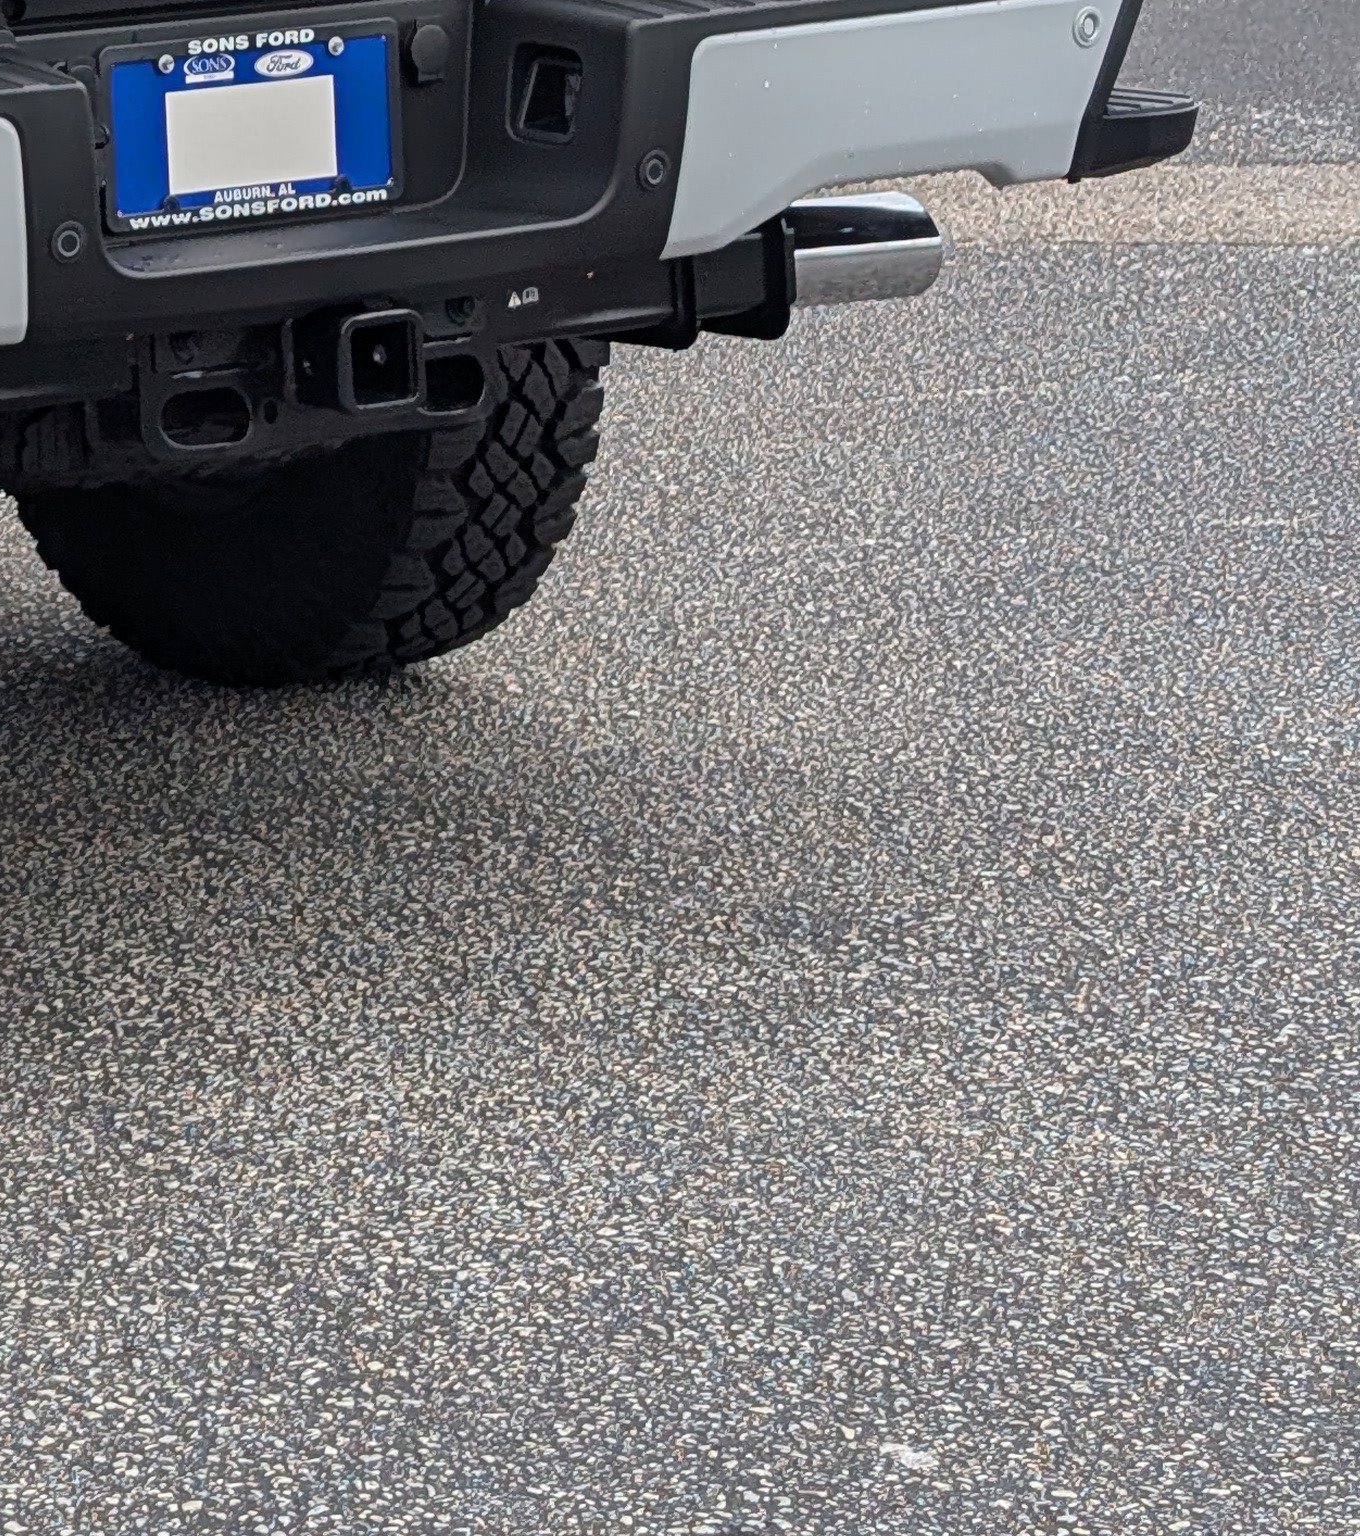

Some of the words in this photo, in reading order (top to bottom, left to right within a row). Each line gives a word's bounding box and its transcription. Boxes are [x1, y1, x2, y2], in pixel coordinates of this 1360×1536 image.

[187, 34, 250, 56] SONS
[255, 28, 315, 49] FORD
[191, 56, 228, 74] SONS
[266, 53, 302, 73] Ford
[277, 182, 297, 196] AL
[129, 187, 388, 231] www.SONSFORD.com
